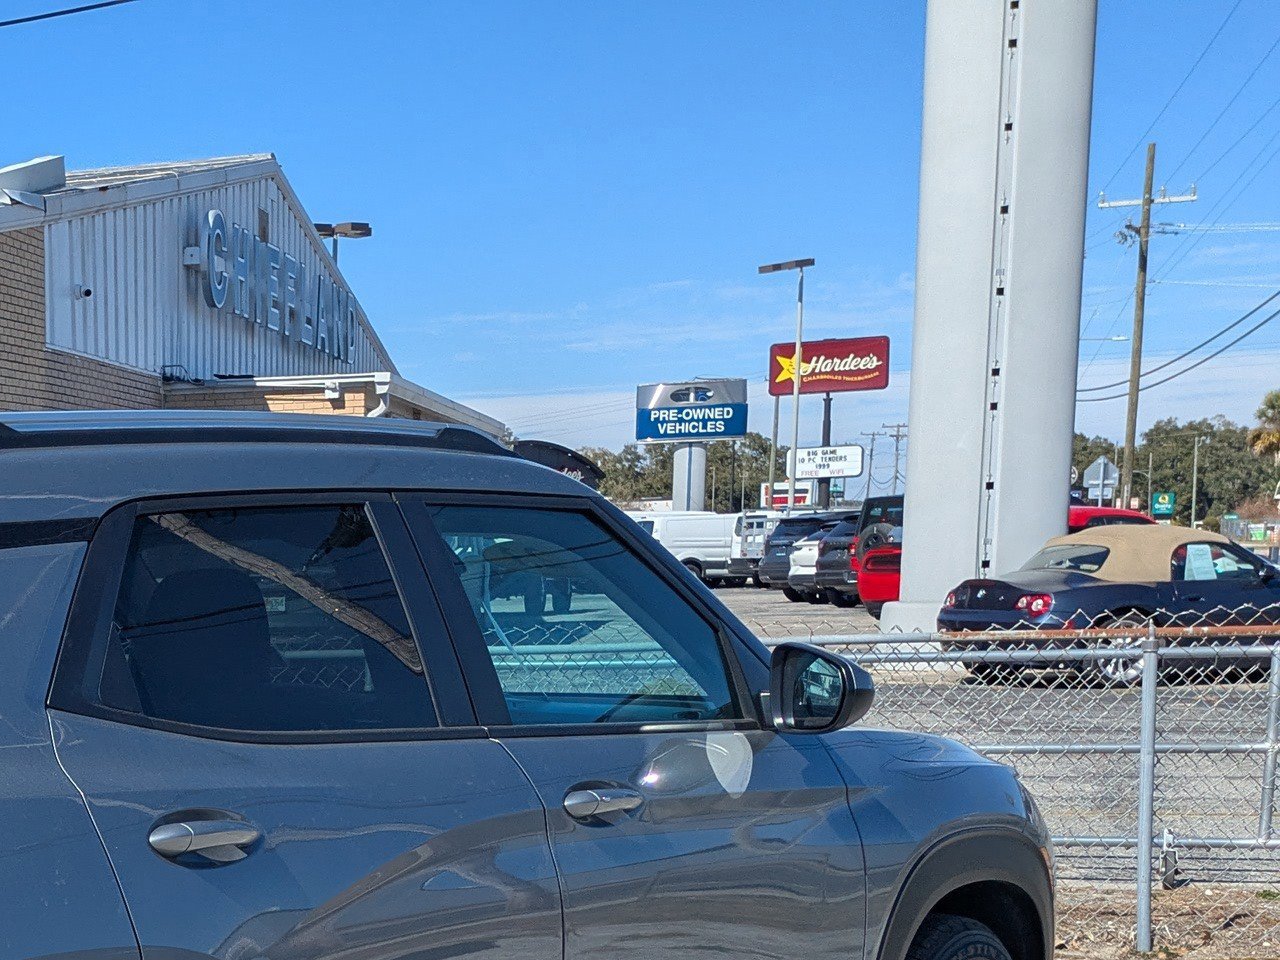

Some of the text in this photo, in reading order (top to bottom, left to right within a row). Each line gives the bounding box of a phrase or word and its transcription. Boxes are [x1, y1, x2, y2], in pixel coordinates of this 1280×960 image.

[201, 209, 356, 364] CHIEFLAND
[800, 353, 883, 376] Hardee's
[650, 407, 734, 421] PRE-OWNED
[657, 421, 725, 434] VEHICLES
